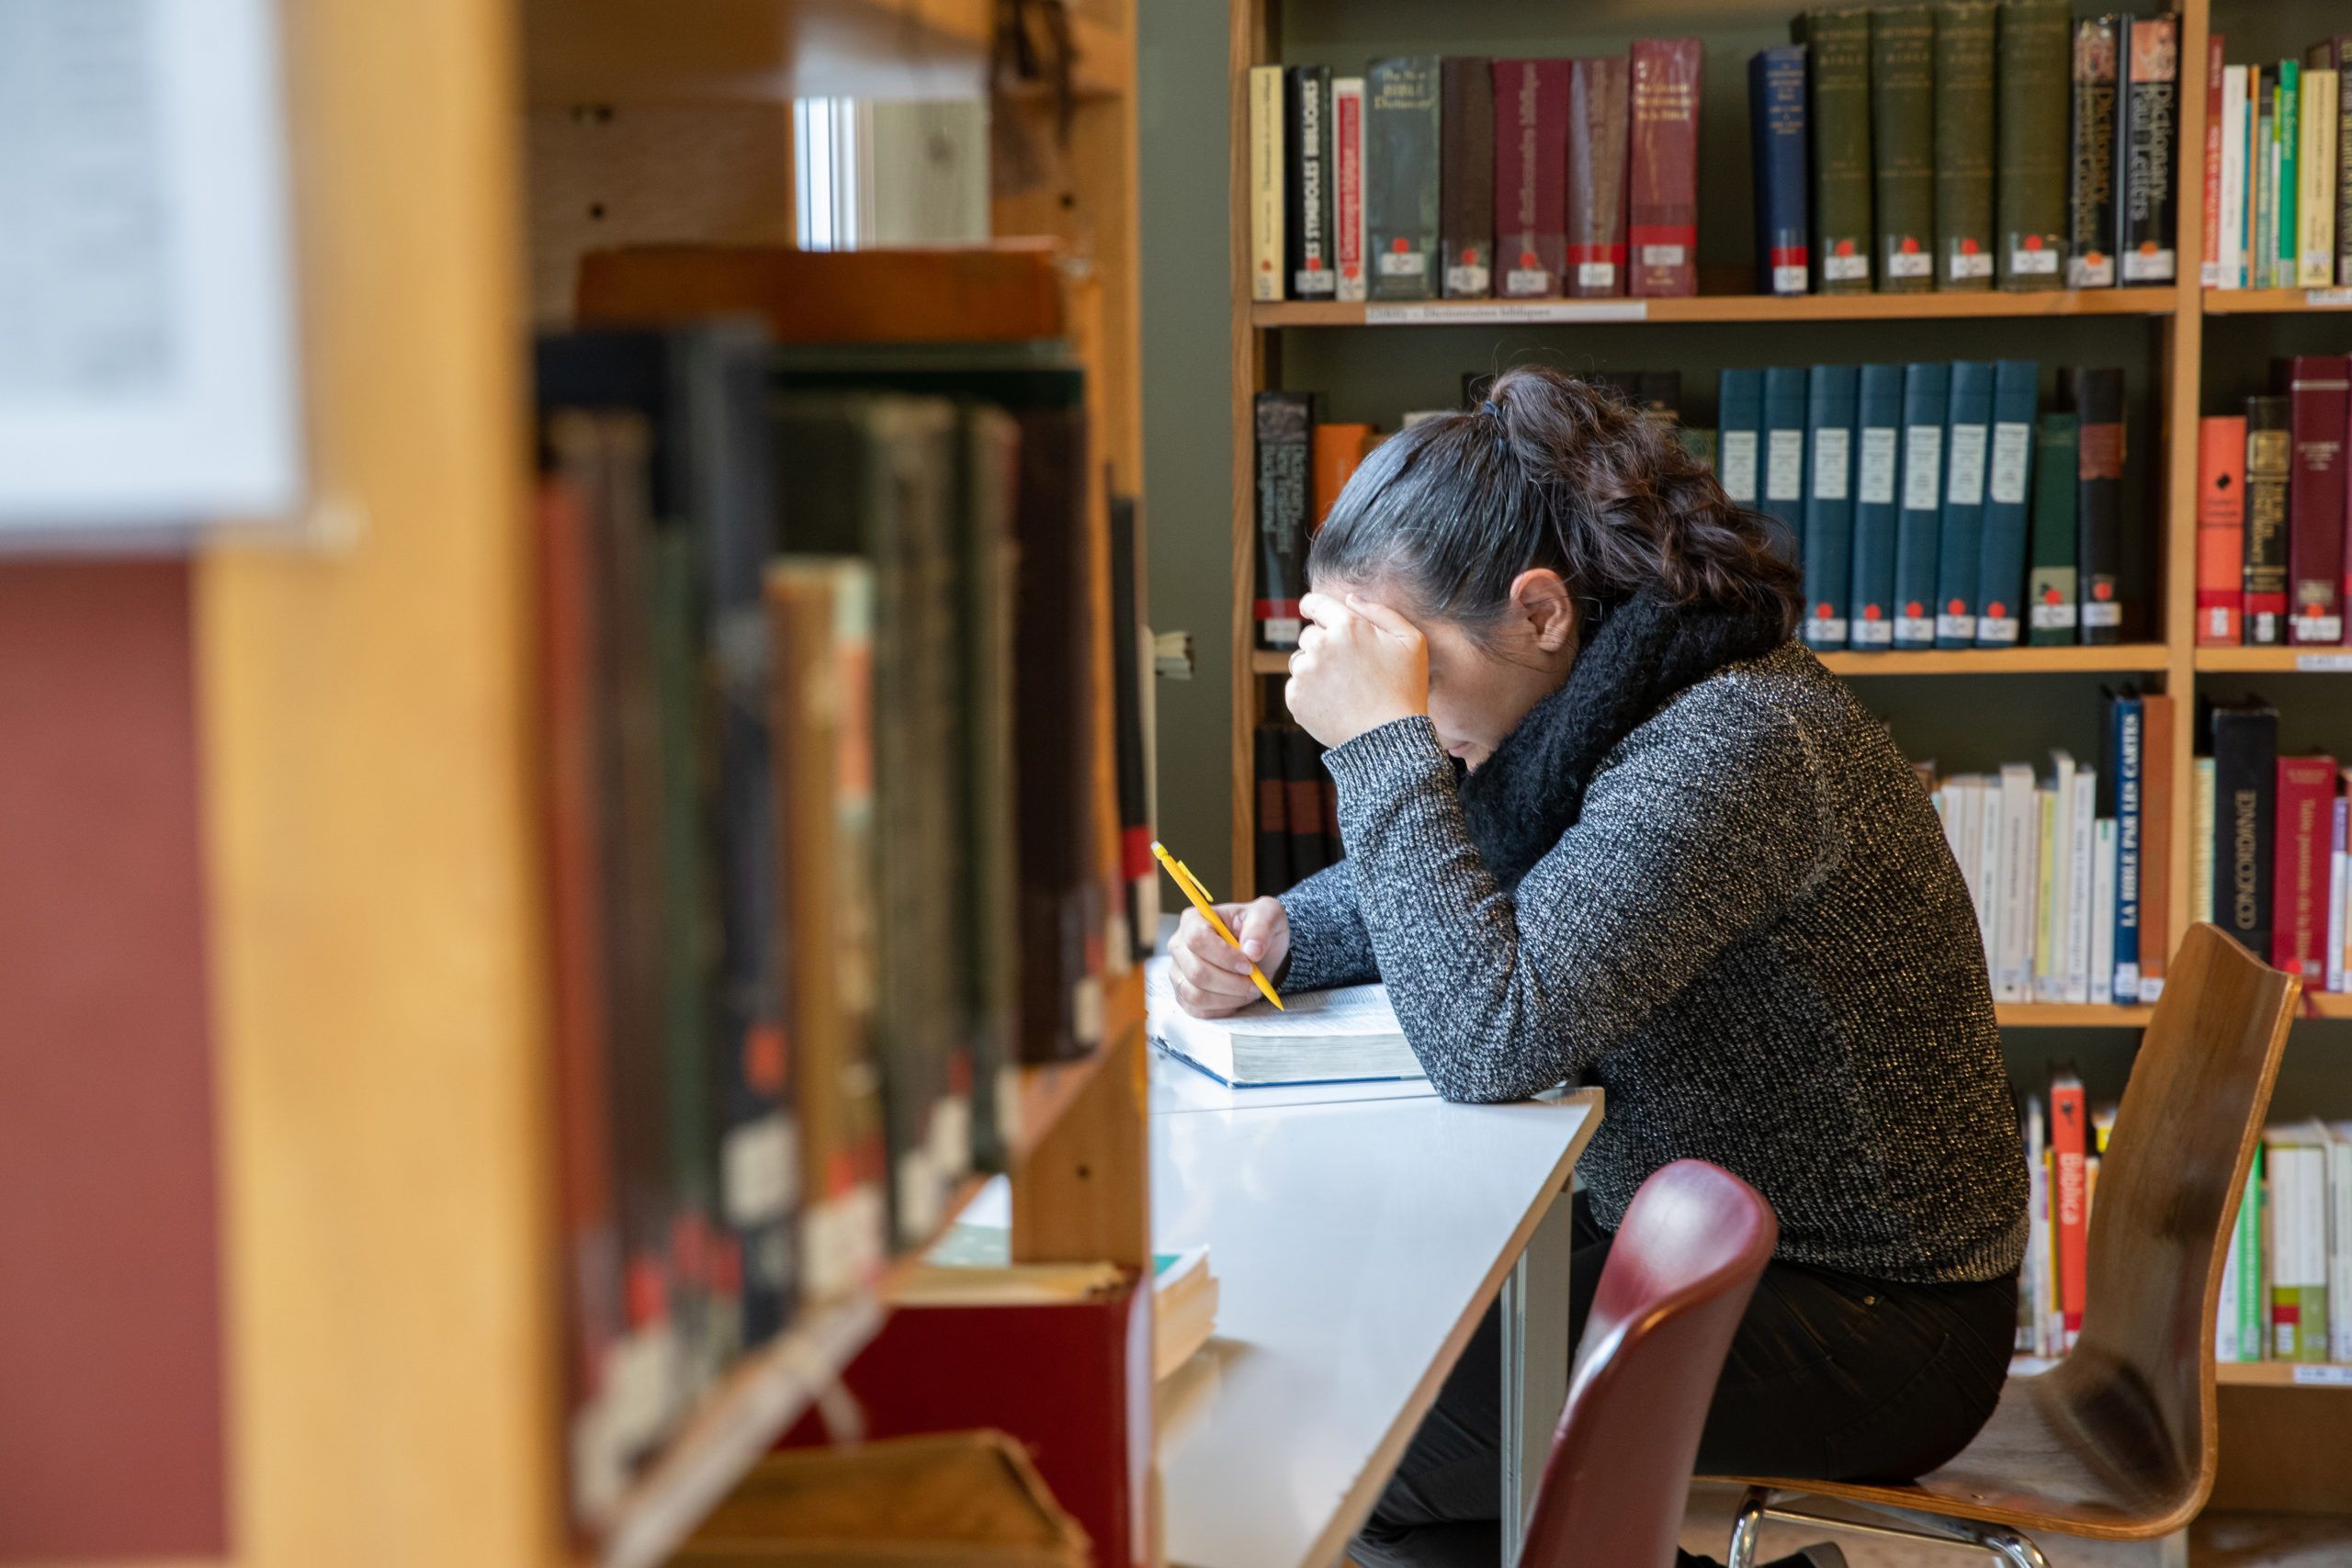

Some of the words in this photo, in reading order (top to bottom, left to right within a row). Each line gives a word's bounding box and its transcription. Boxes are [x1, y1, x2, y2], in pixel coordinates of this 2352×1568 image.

[1303, 80, 1319, 156] BIBLIQUES
[2132, 85, 2152, 130] Paul
[2150, 84, 2173, 201] Dictionary
[2095, 86, 2115, 203] Dictionary
[1304, 160, 1320, 238] SYMBOLES
[2131, 144, 2152, 220] Letters
[2122, 714, 2139, 778] CARTES
[2122, 782, 2139, 811] LES
[2122, 816, 2138, 848] PAR
[2121, 852, 2138, 901] BIBLE
[2235, 790, 2256, 930] CONCORDANCE
[2121, 906, 2137, 927] LA
[2060, 1153, 2085, 1224] Biblica
